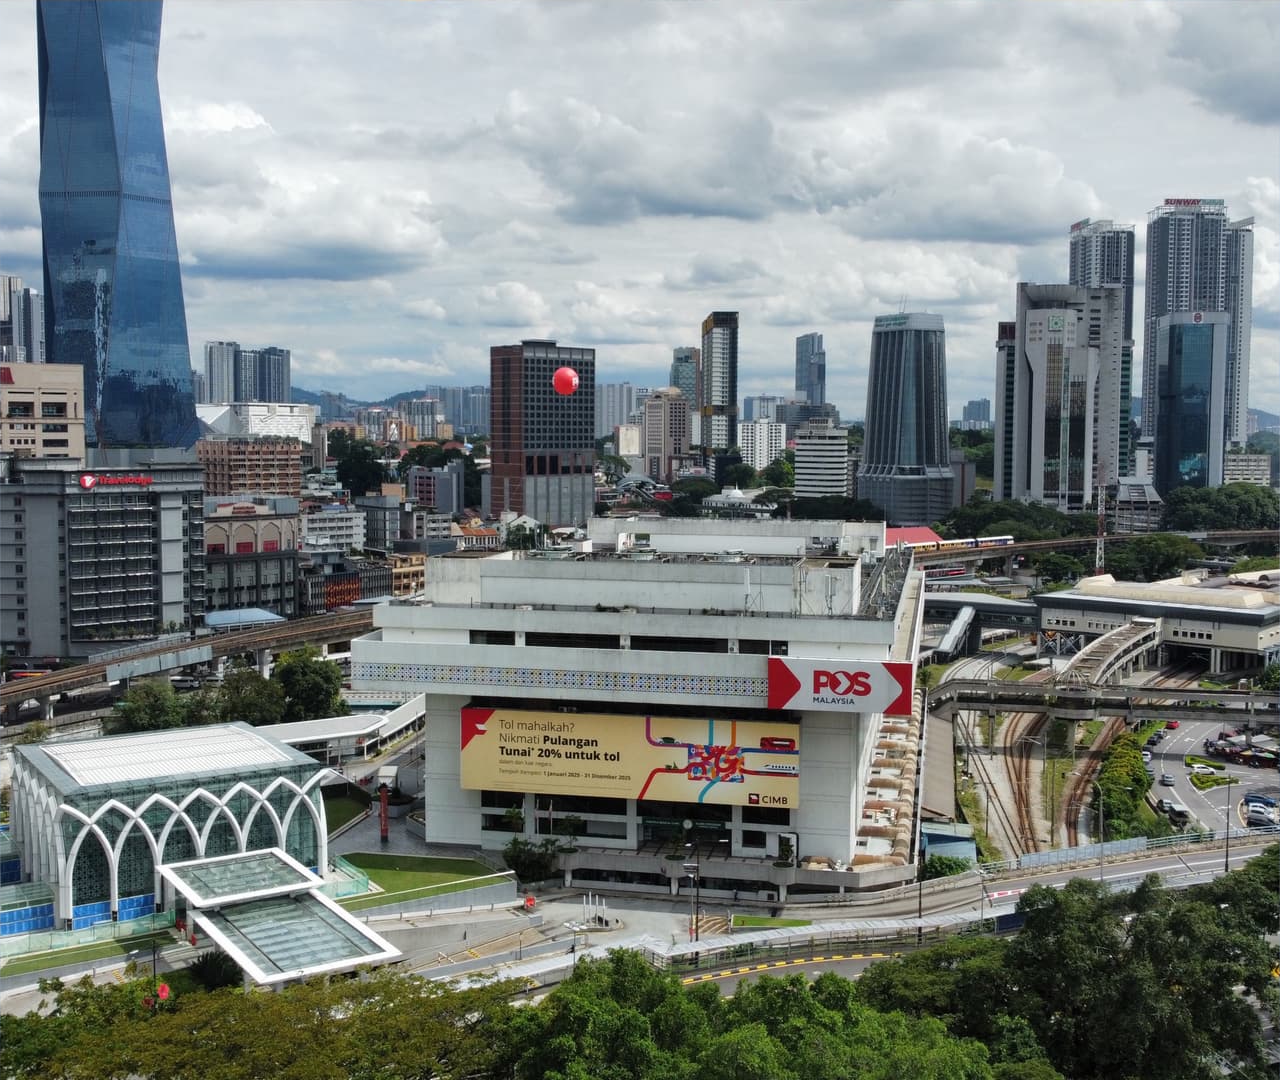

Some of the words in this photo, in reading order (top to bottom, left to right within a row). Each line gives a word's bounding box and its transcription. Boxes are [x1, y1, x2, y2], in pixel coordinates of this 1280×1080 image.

[98, 475, 154, 487] Travelodge
[813, 669, 872, 696] POS
[813, 696, 855, 705] MALAYSIA
[498, 720, 514, 730] Tol
[516, 720, 575, 733] mahalkah?
[499, 733, 540, 745] Nikmati
[543, 735, 598, 749] Pulangan
[537, 748, 562, 759] 20%
[565, 750, 600, 761] untuk
[604, 751, 620, 762] tol
[761, 795, 788, 805] CIMB
